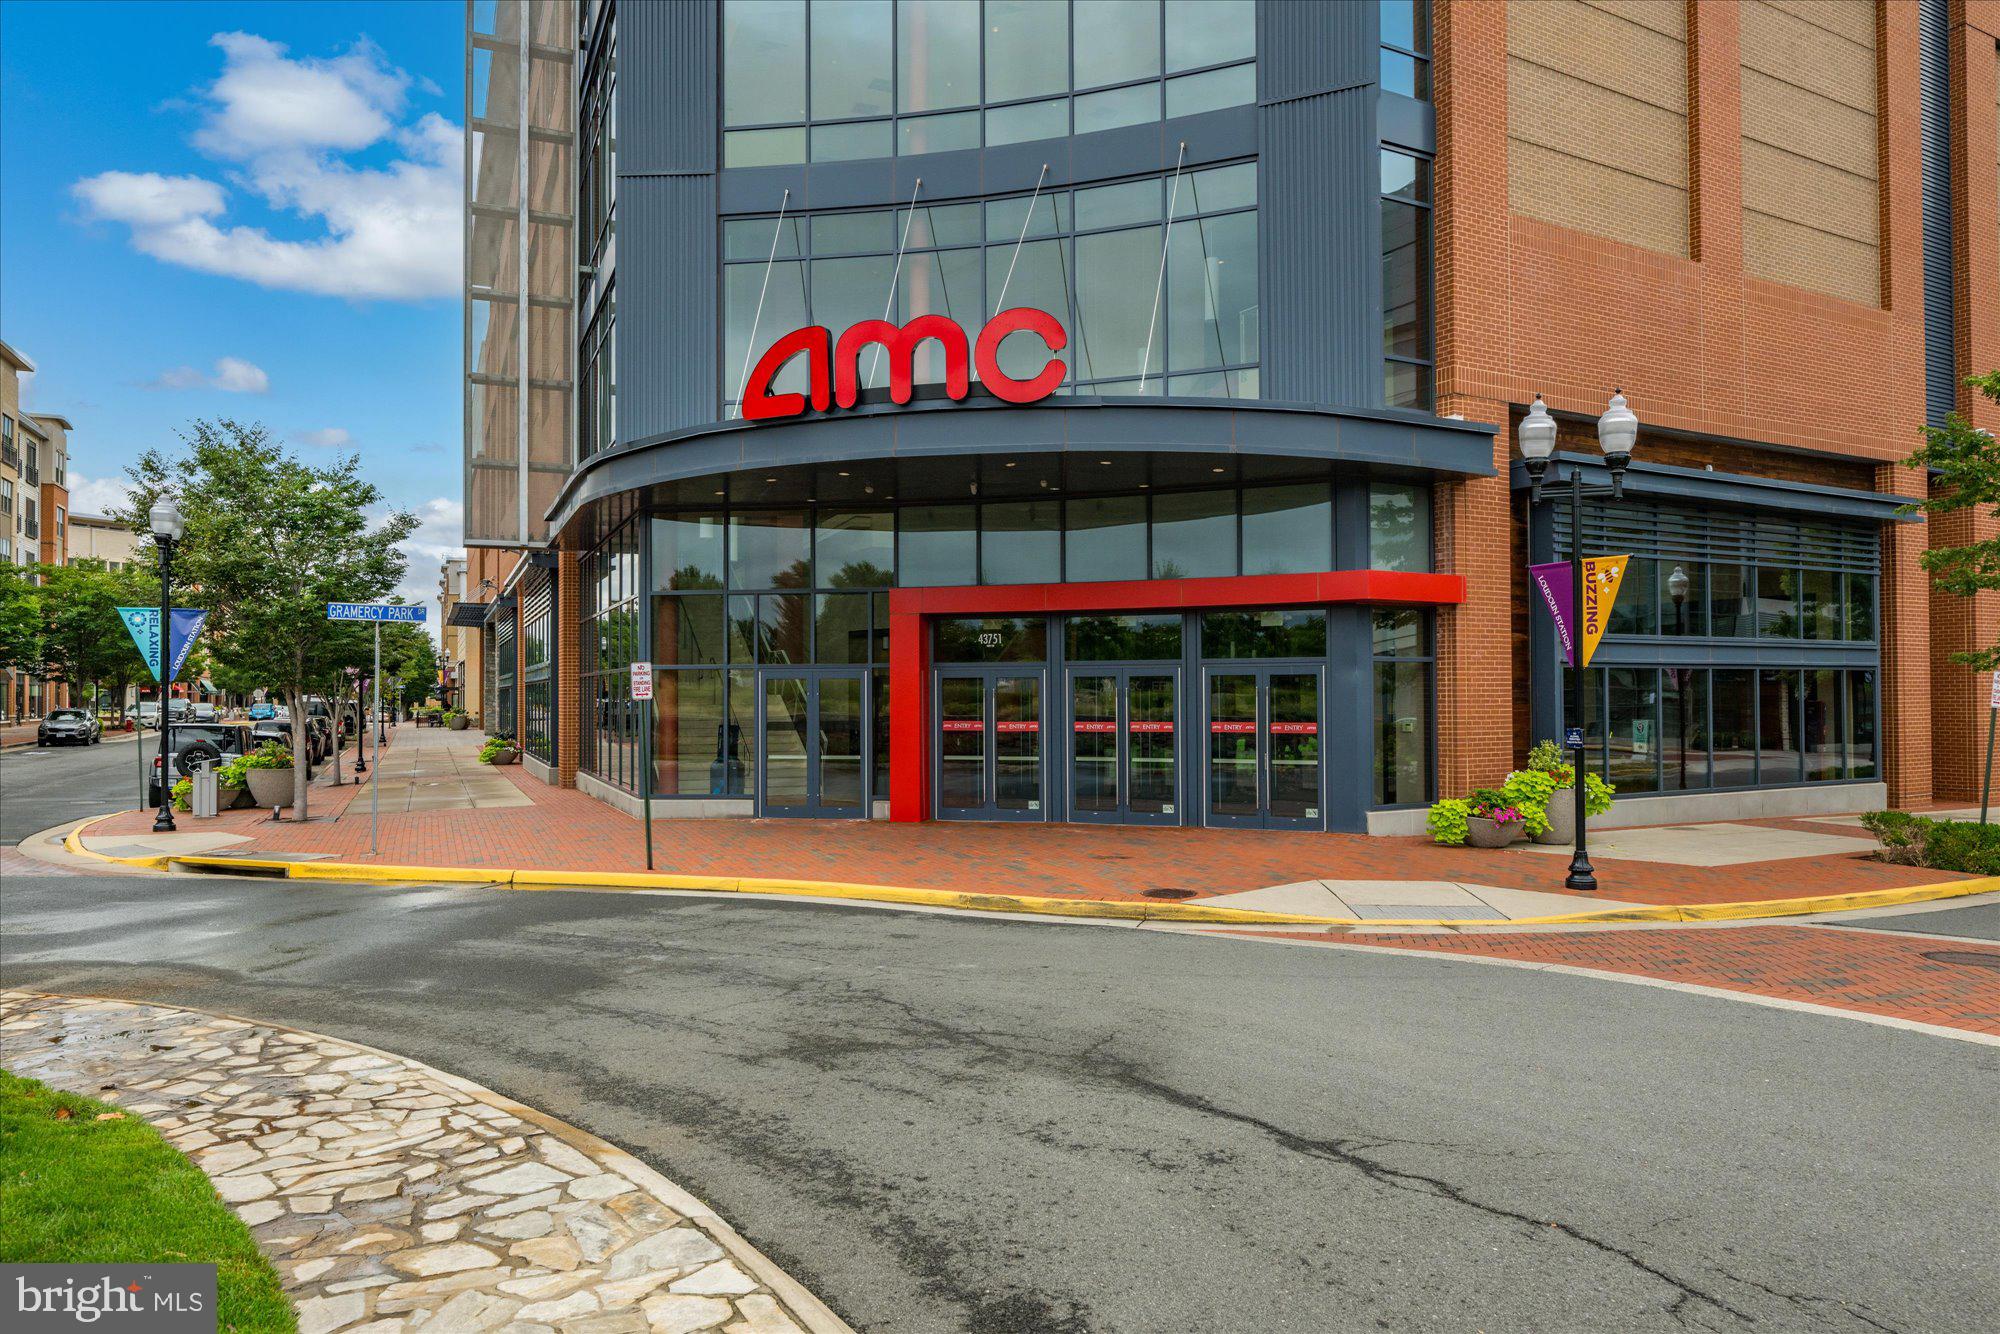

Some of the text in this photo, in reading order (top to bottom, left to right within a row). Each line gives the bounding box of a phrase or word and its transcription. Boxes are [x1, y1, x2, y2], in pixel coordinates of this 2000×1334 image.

[329, 604, 384, 619] GRAMERCY
[388, 607, 414, 620] PARK
[1538, 575, 1572, 651] LOUDOUN STATION
[1585, 561, 1599, 635] BUZZING
[149, 609, 159, 667] RELAXING
[173, 616, 204, 670] LOUDOUN STATION
[978, 633, 1002, 645] 43751
